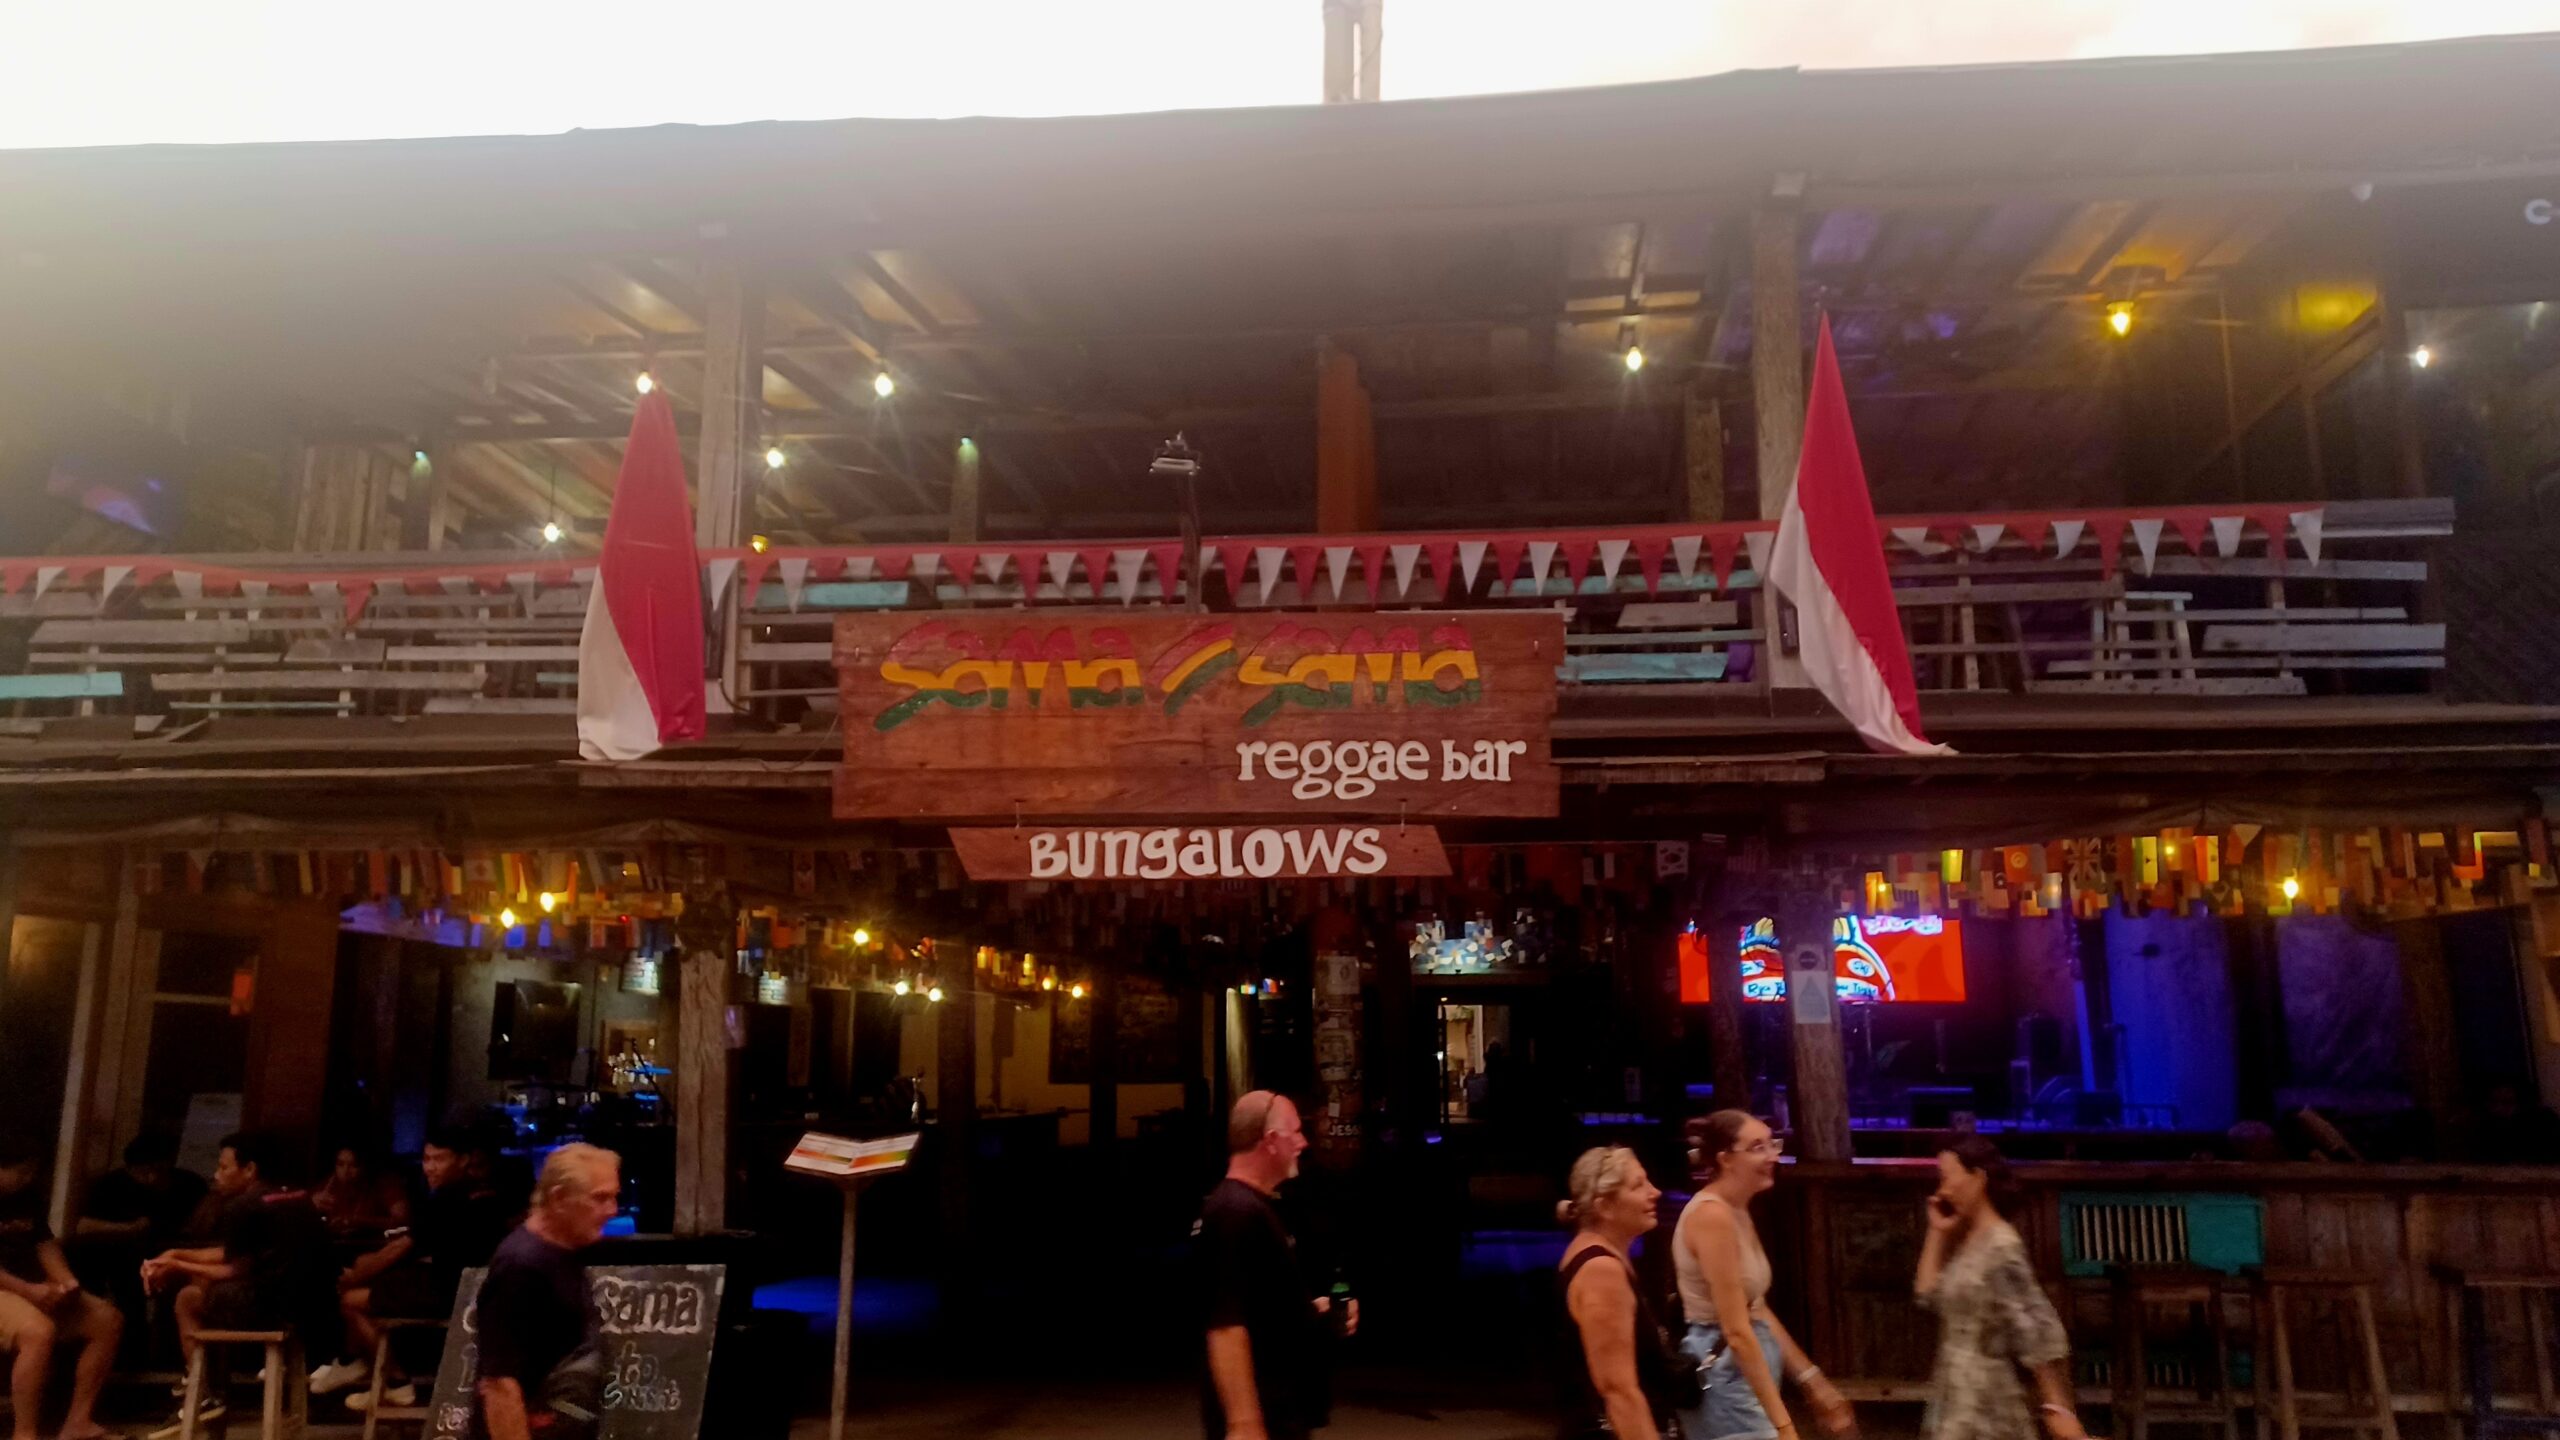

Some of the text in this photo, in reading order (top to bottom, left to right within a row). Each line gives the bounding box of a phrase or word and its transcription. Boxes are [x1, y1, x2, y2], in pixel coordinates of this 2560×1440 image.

[873, 620, 1482, 732] Sama Sama
[1235, 738, 1527, 800] reggae bar
